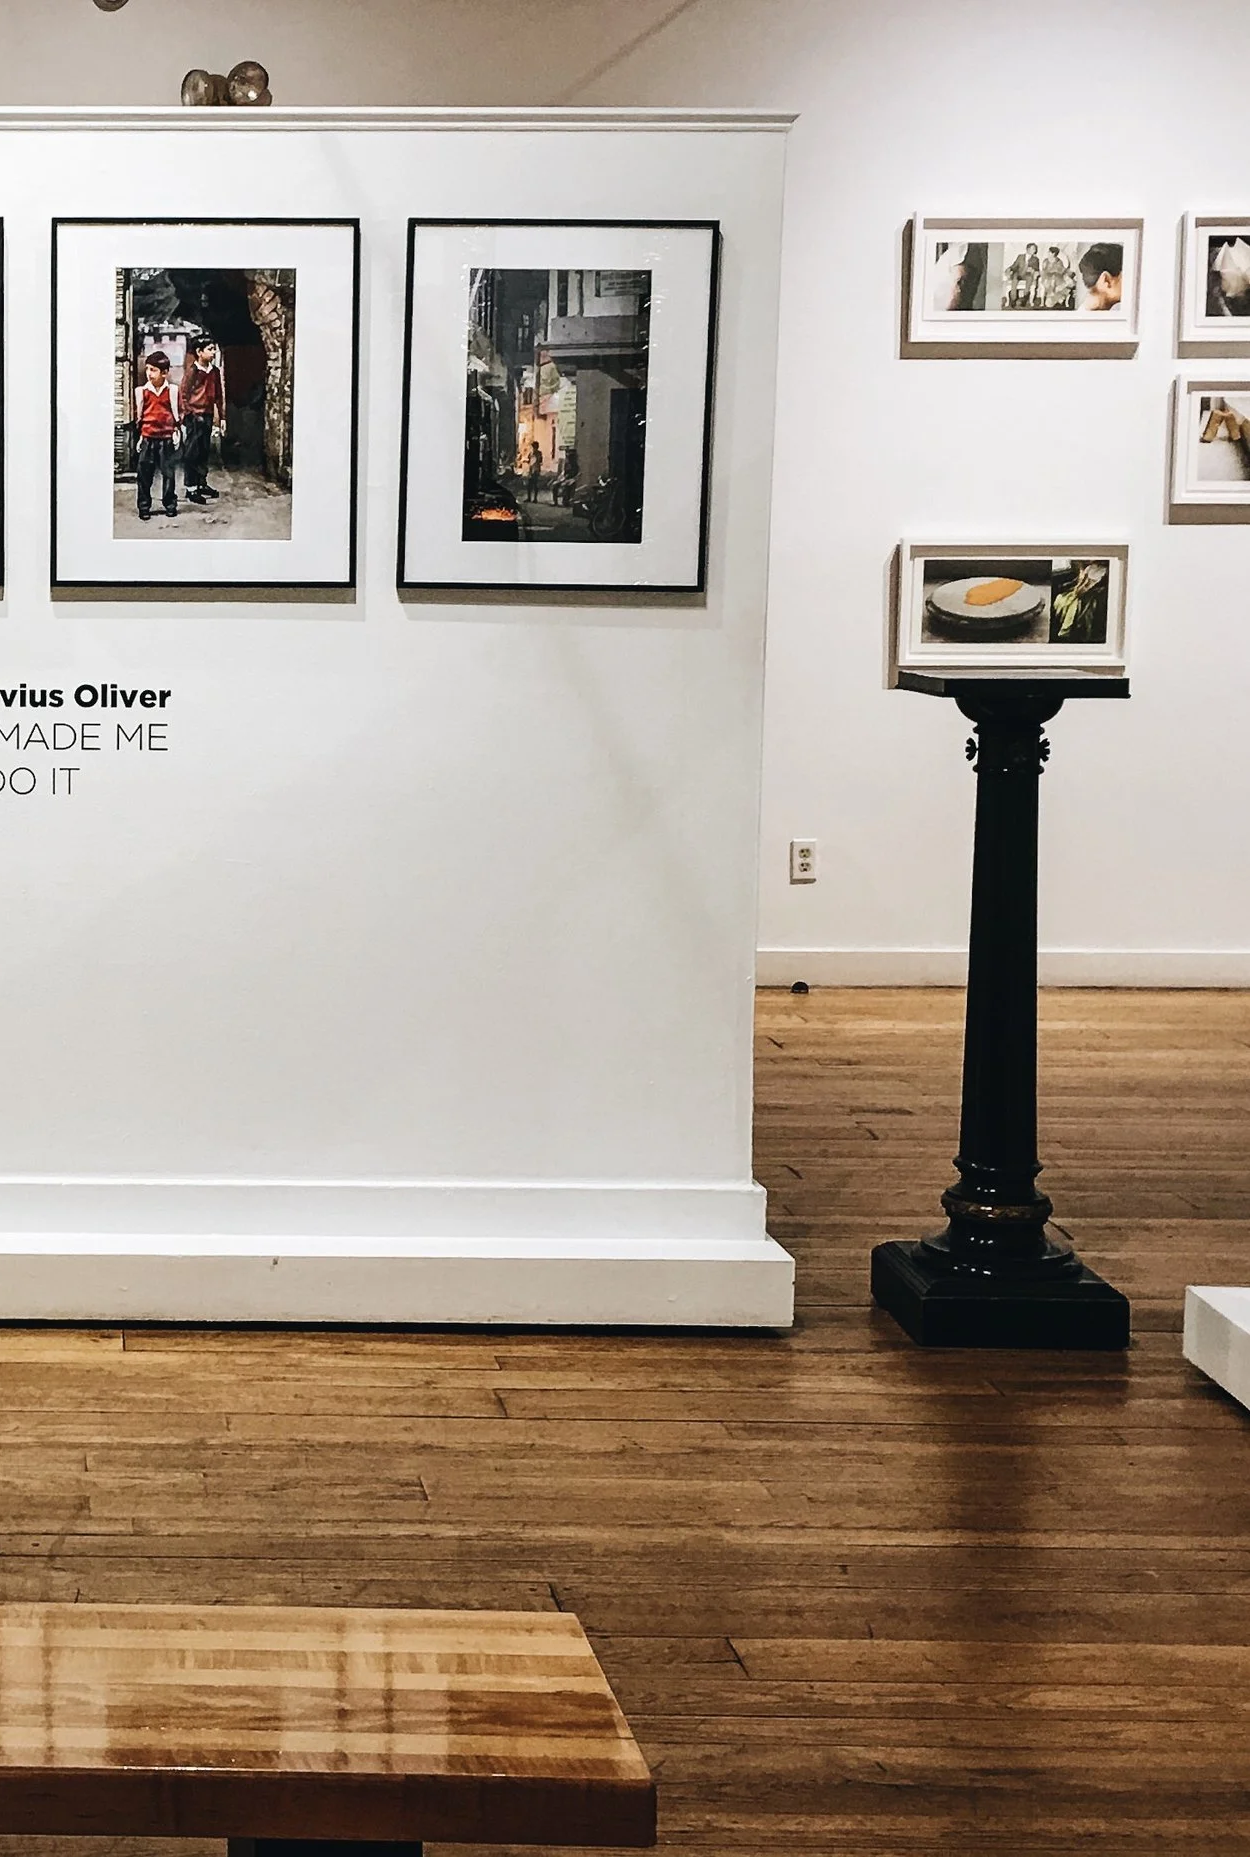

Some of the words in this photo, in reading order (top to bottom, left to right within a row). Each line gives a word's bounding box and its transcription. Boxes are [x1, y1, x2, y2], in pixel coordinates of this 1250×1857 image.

[74, 684, 171, 708] Oliver
[117, 724, 168, 751] ME
[53, 768, 80, 794] IT
